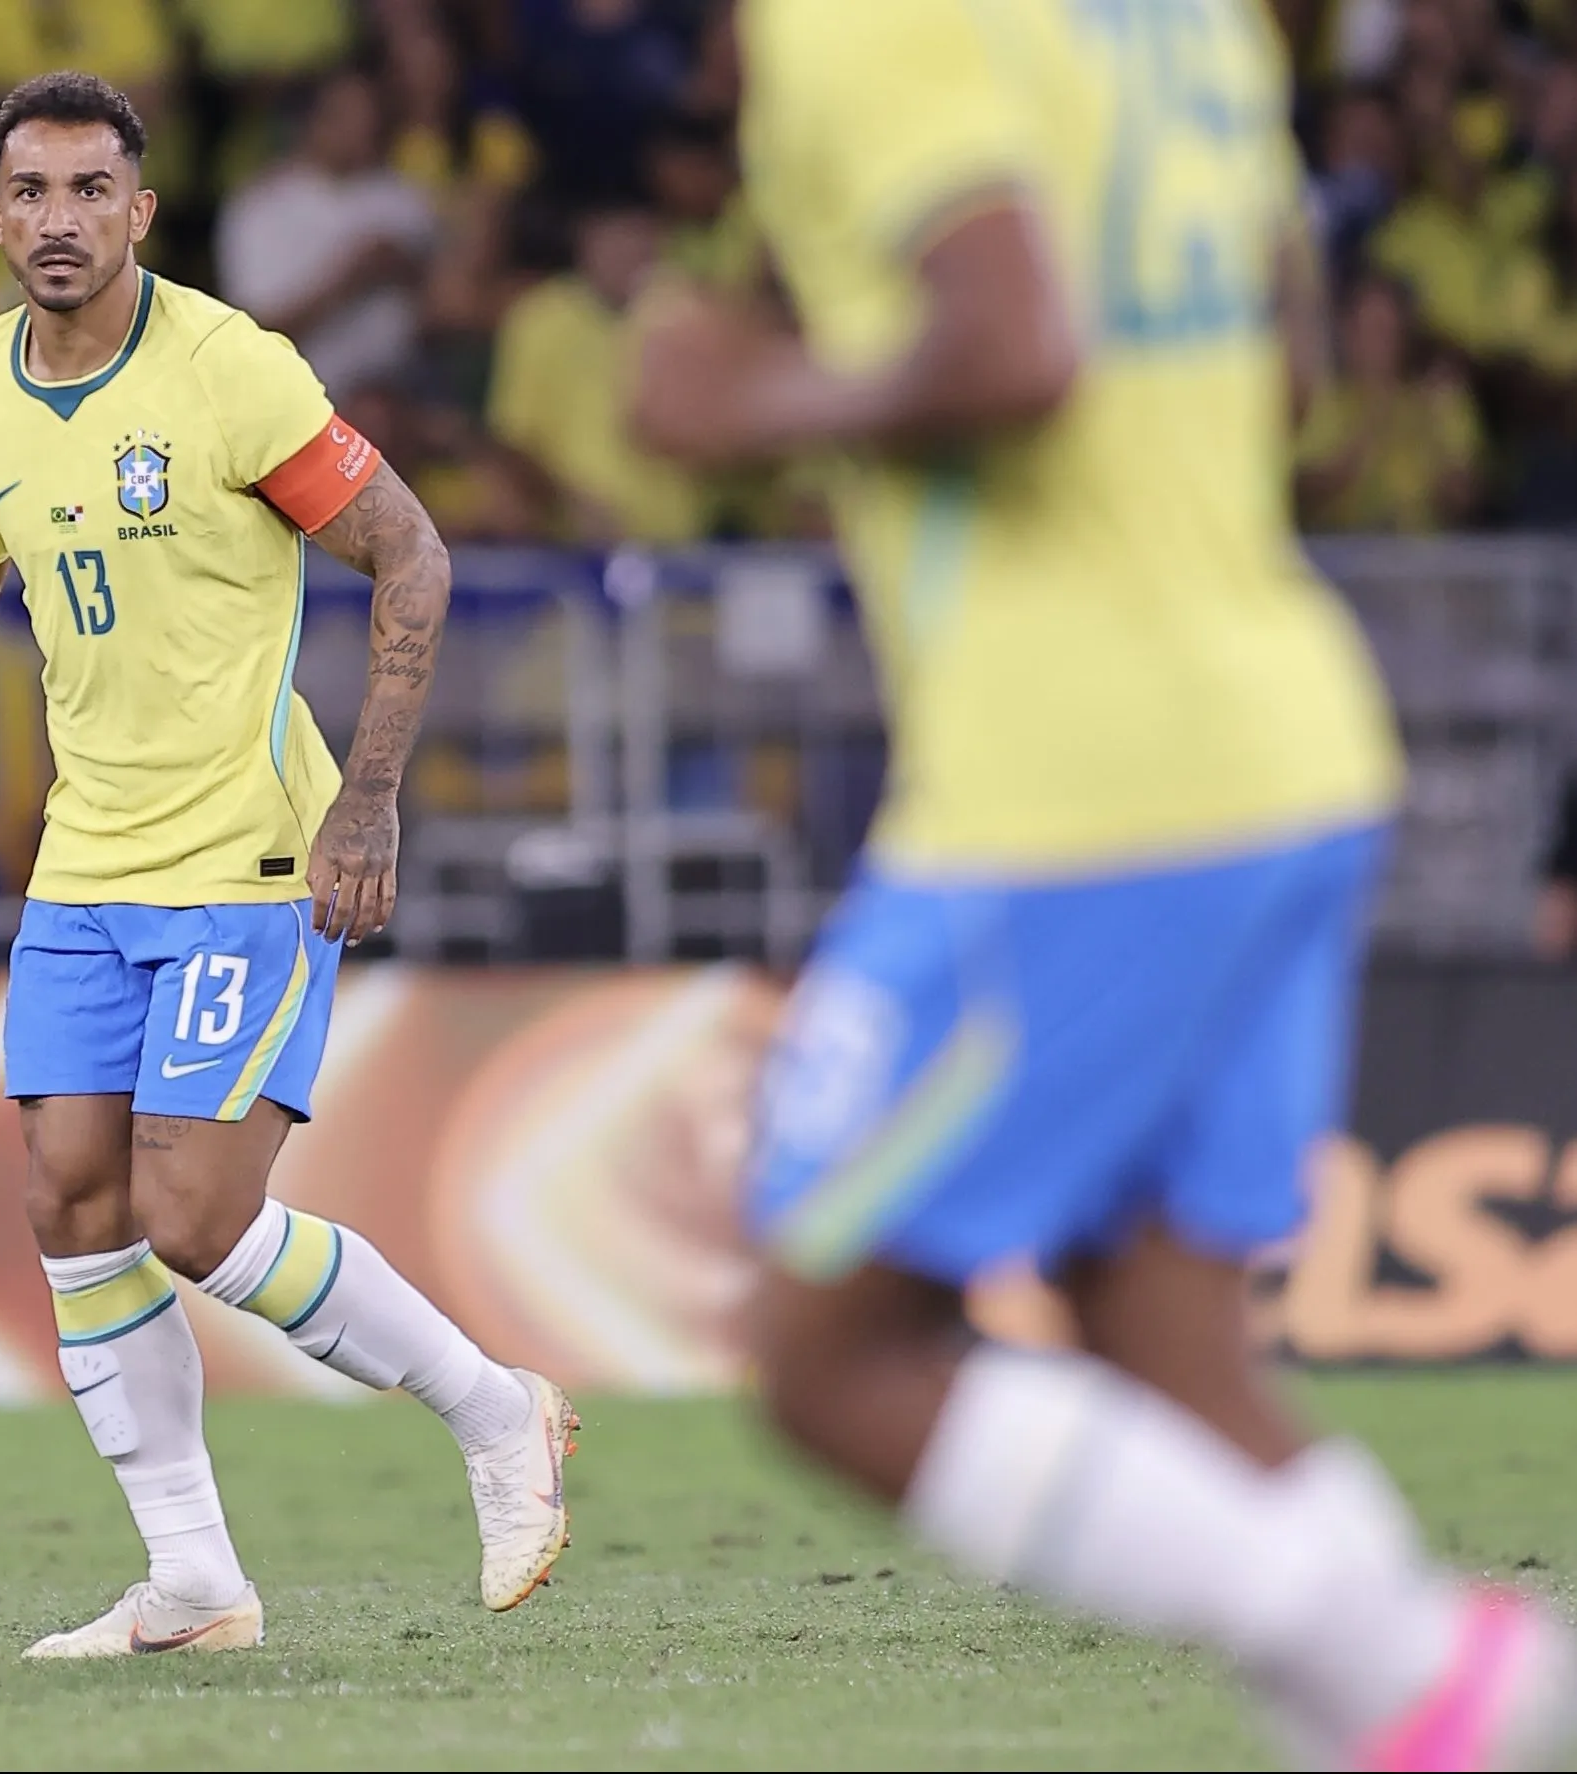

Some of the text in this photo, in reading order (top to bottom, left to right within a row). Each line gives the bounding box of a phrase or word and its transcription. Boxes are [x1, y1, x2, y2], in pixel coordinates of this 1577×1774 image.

[130, 474, 151, 485] CBF
[117, 523, 179, 541] BRASIL
[56, 550, 116, 636] 13
[382, 632, 429, 665] stay
[370, 655, 429, 690] strong
[174, 951, 251, 1046] 13
